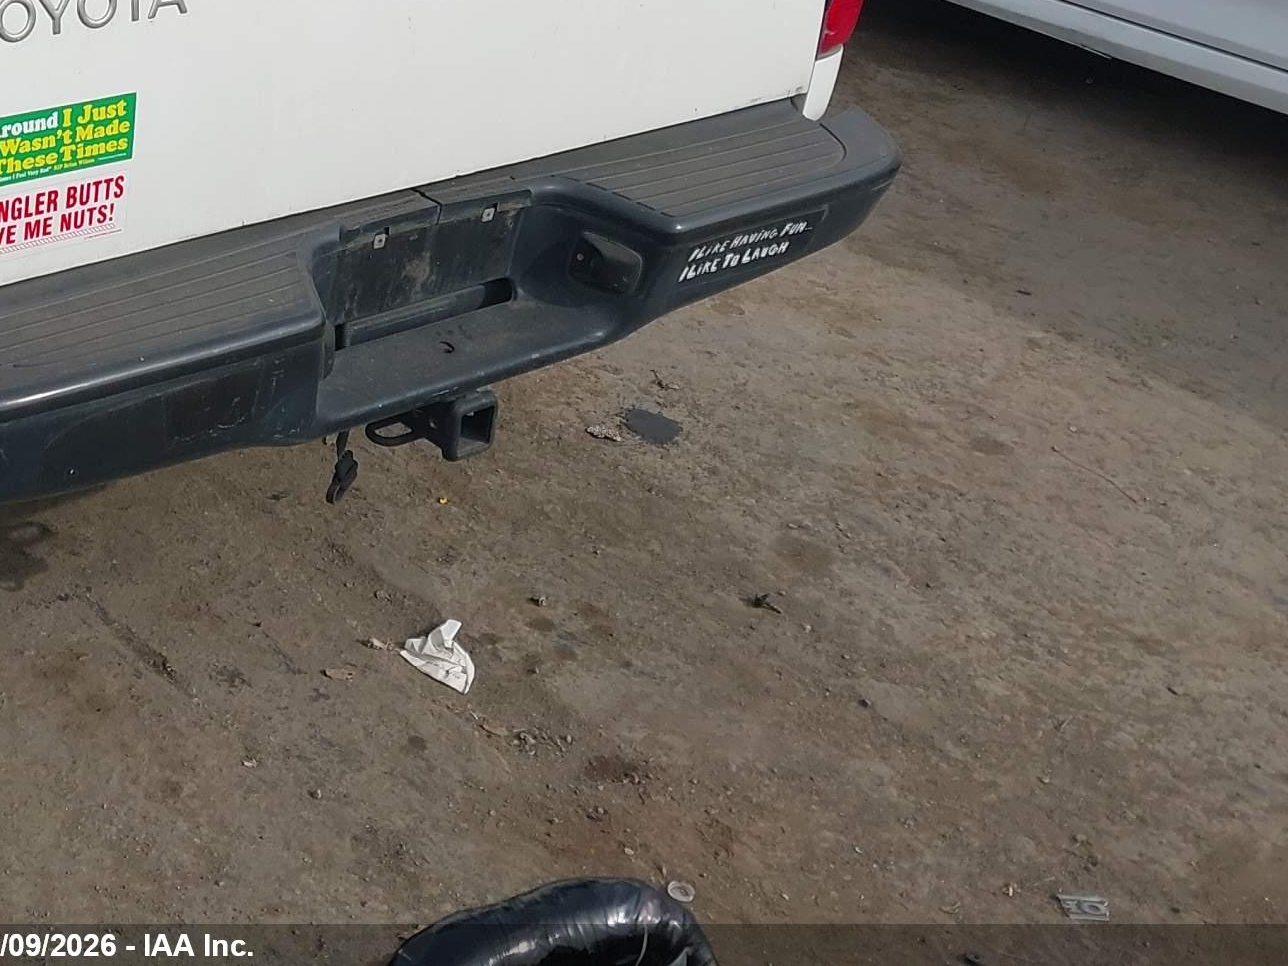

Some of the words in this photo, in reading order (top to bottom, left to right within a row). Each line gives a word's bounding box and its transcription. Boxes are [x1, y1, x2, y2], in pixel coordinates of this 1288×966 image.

[62, 108, 72, 127] I
[77, 99, 127, 124] Just
[75, 119, 130, 143] Made
[60, 137, 128, 161] Times
[65, 175, 125, 209] BUTTS
[23, 217, 53, 240] ME
[60, 203, 115, 232] NUTS!
[722, 253, 741, 269] TO
[741, 241, 790, 264] LAUGH
